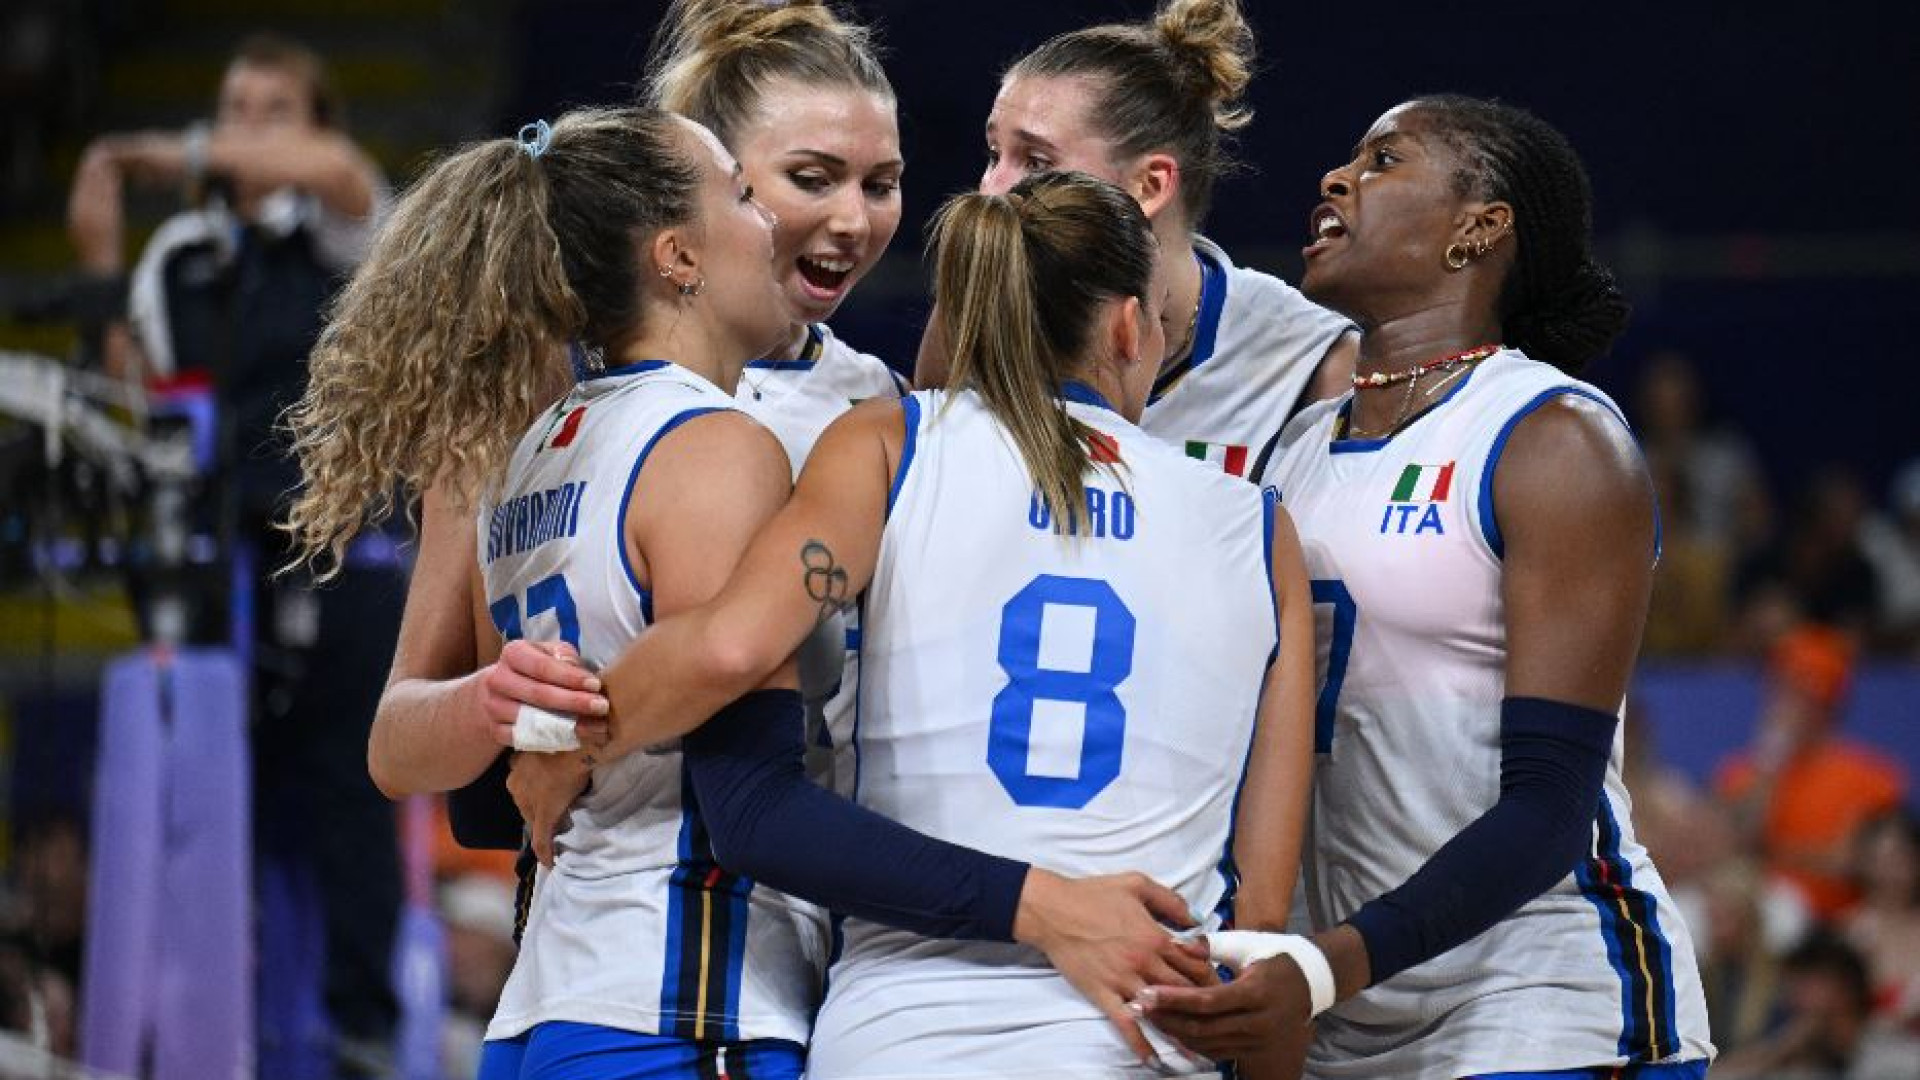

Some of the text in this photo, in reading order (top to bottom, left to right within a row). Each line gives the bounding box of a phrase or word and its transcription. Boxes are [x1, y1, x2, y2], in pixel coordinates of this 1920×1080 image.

[1028, 486, 1135, 541] ORO
[1380, 503, 1445, 535] ITA
[986, 573, 1137, 809] 8
